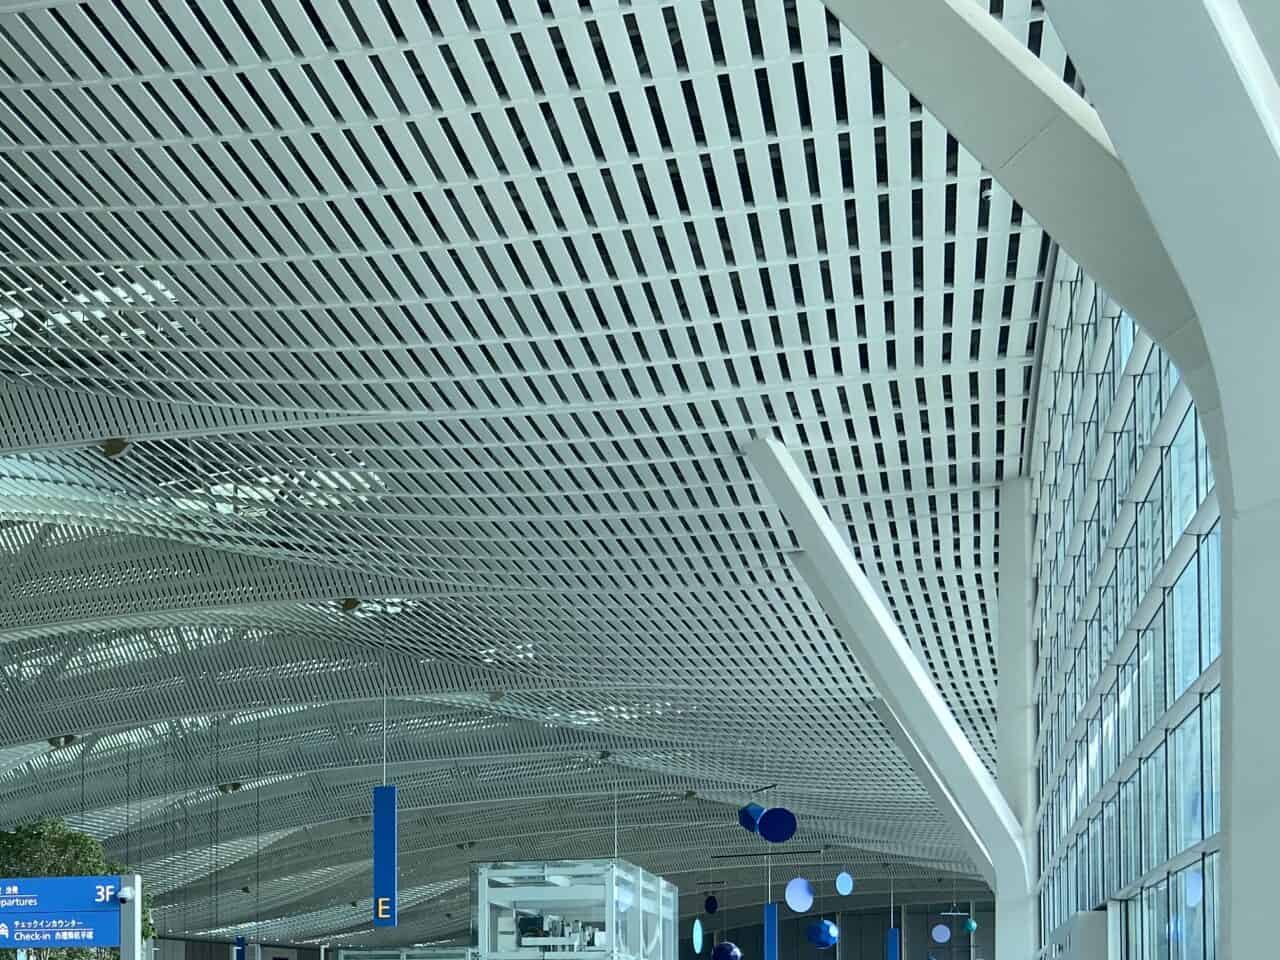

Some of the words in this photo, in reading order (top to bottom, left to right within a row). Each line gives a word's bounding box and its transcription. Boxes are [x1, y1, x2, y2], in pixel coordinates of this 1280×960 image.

[95, 886, 114, 902] 3F
[378, 897, 391, 918] E
[14, 931, 51, 941] Check-in
